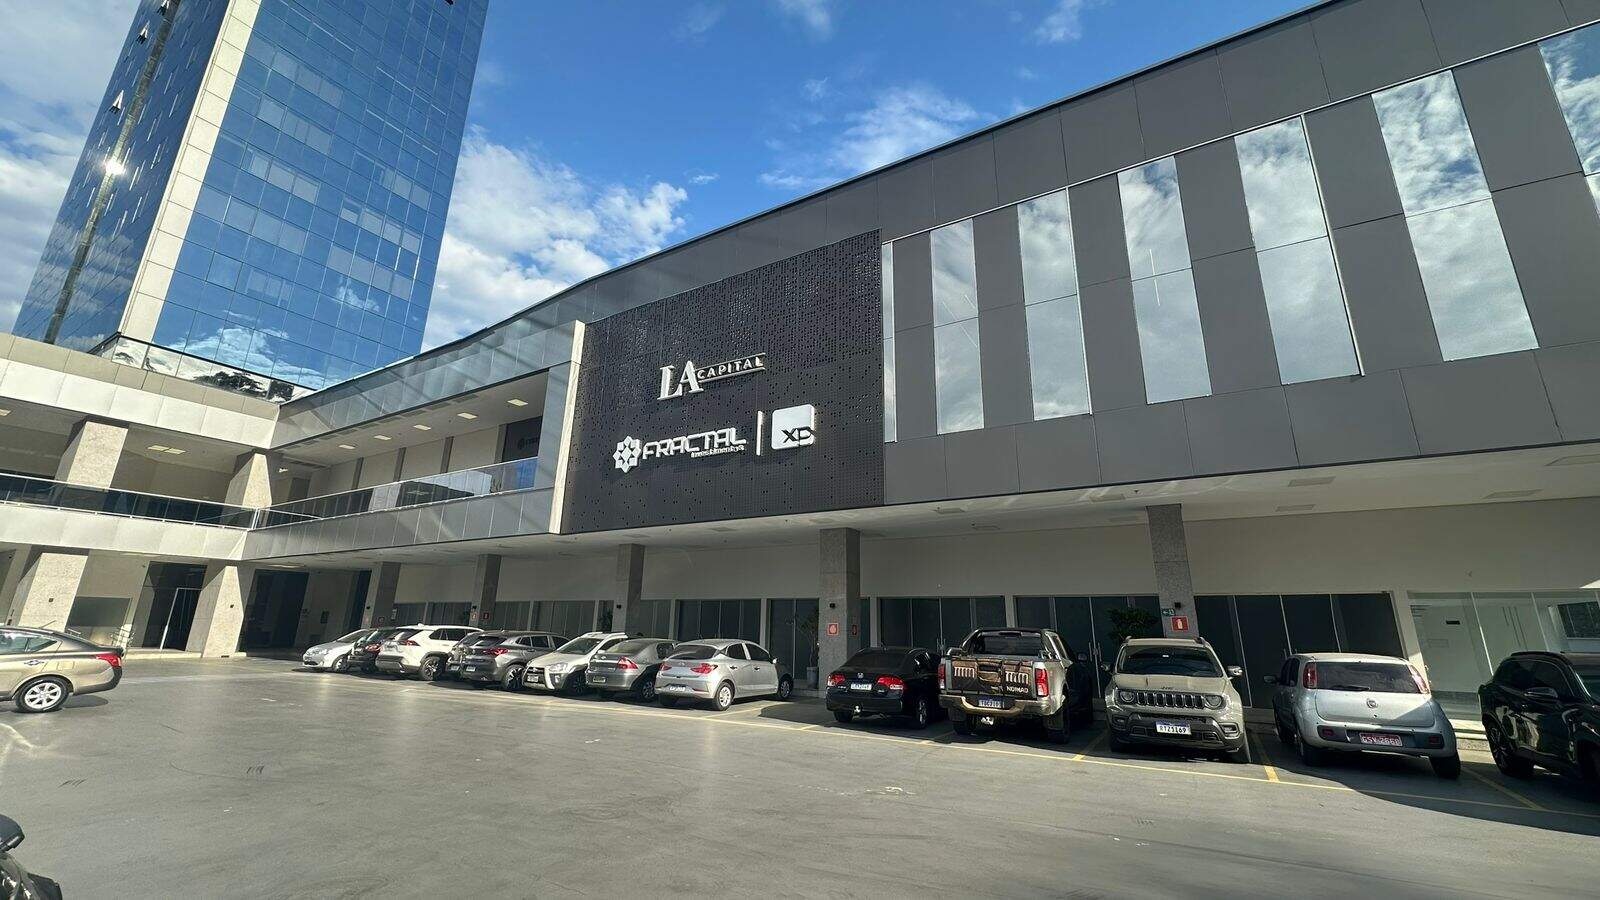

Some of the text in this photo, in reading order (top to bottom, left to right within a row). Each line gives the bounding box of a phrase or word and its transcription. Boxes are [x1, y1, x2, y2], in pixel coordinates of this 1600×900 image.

[657, 357, 764, 400] LA CAPITAL
[642, 427, 746, 460] FRACTAL
[781, 426, 814, 445] XP
